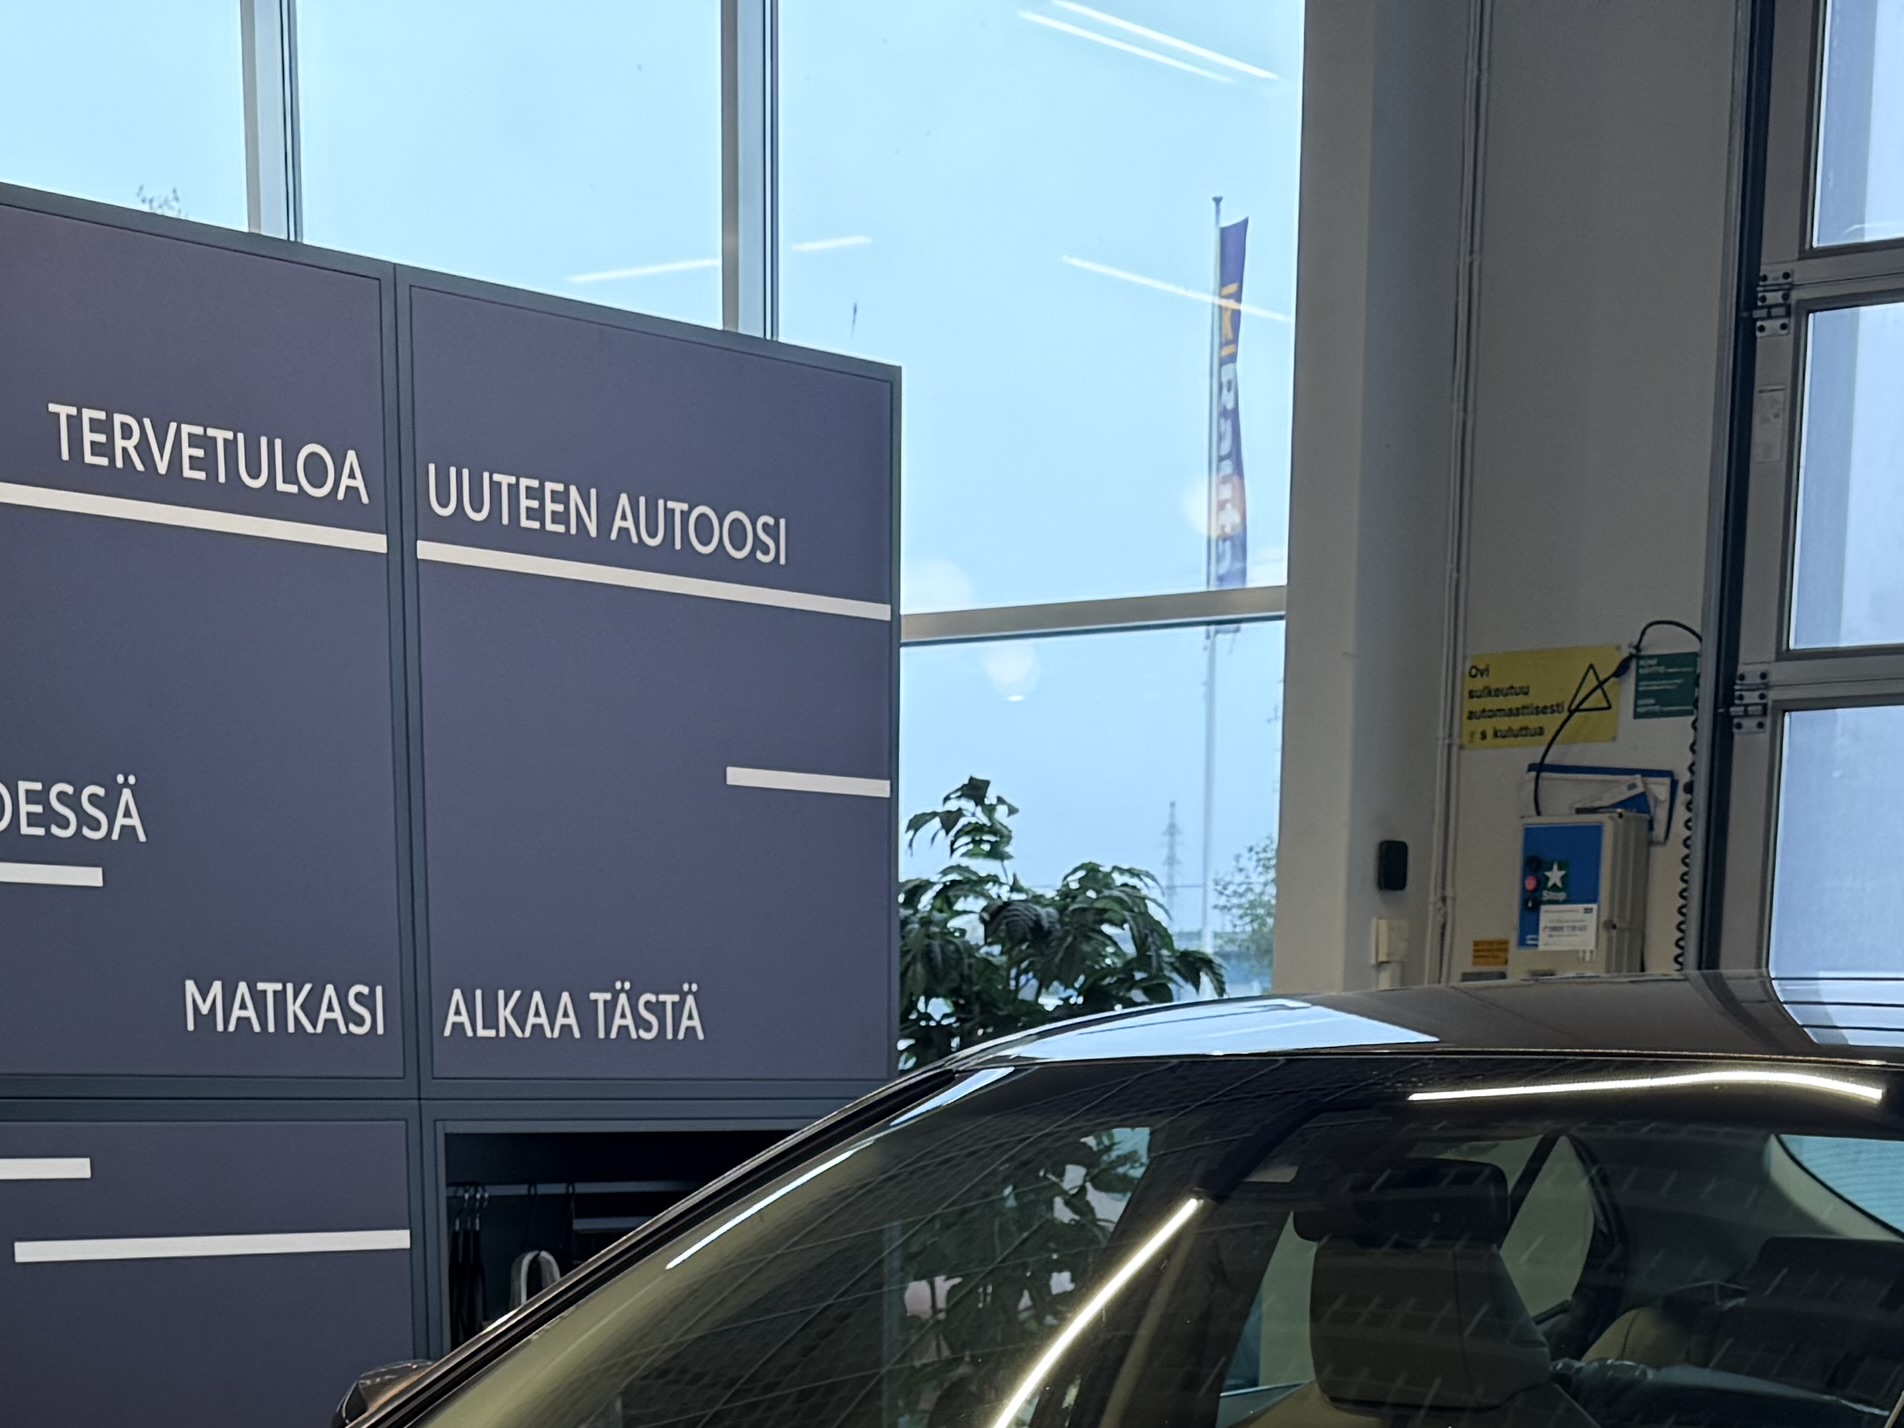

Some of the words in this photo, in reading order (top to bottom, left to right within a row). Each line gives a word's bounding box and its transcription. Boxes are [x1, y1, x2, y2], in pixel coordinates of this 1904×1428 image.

[48, 402, 370, 506] TERVETULOA
[427, 462, 598, 539] UUTEEN
[609, 492, 787, 565] AUTOOSI
[1468, 664, 1490, 679] Ovi
[184, 979, 384, 1035] MATKASI
[443, 988, 581, 1039] ALKAA
[589, 980, 705, 1041] TÄSTÄ
